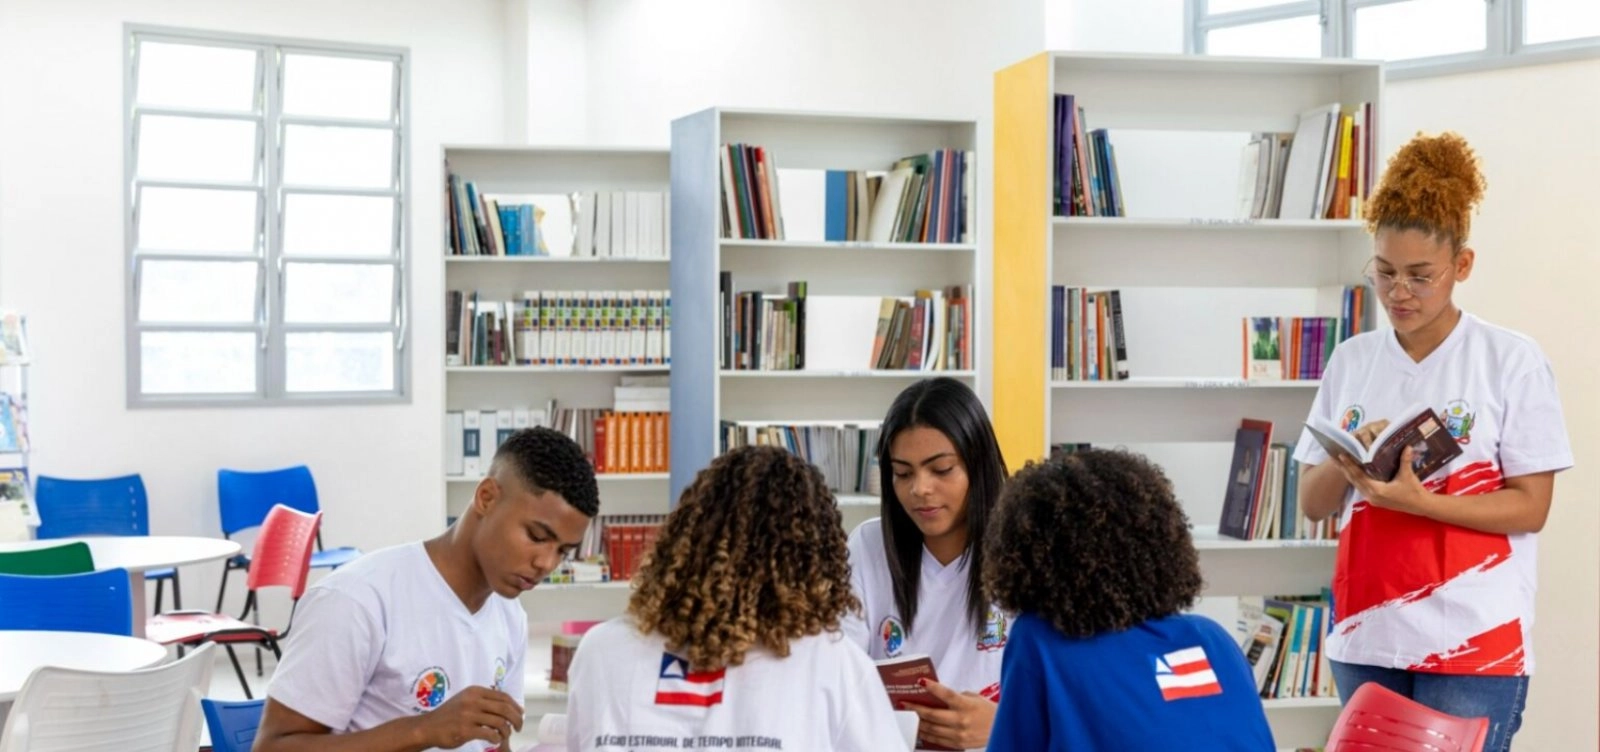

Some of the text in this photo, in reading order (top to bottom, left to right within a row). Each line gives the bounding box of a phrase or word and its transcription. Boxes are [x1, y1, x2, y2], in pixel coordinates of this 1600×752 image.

[628, 735, 678, 748] ESTADUAL
[682, 736, 694, 749] DE
[698, 735, 734, 748] TEMPO
[736, 735, 782, 750] INTEGRAL
